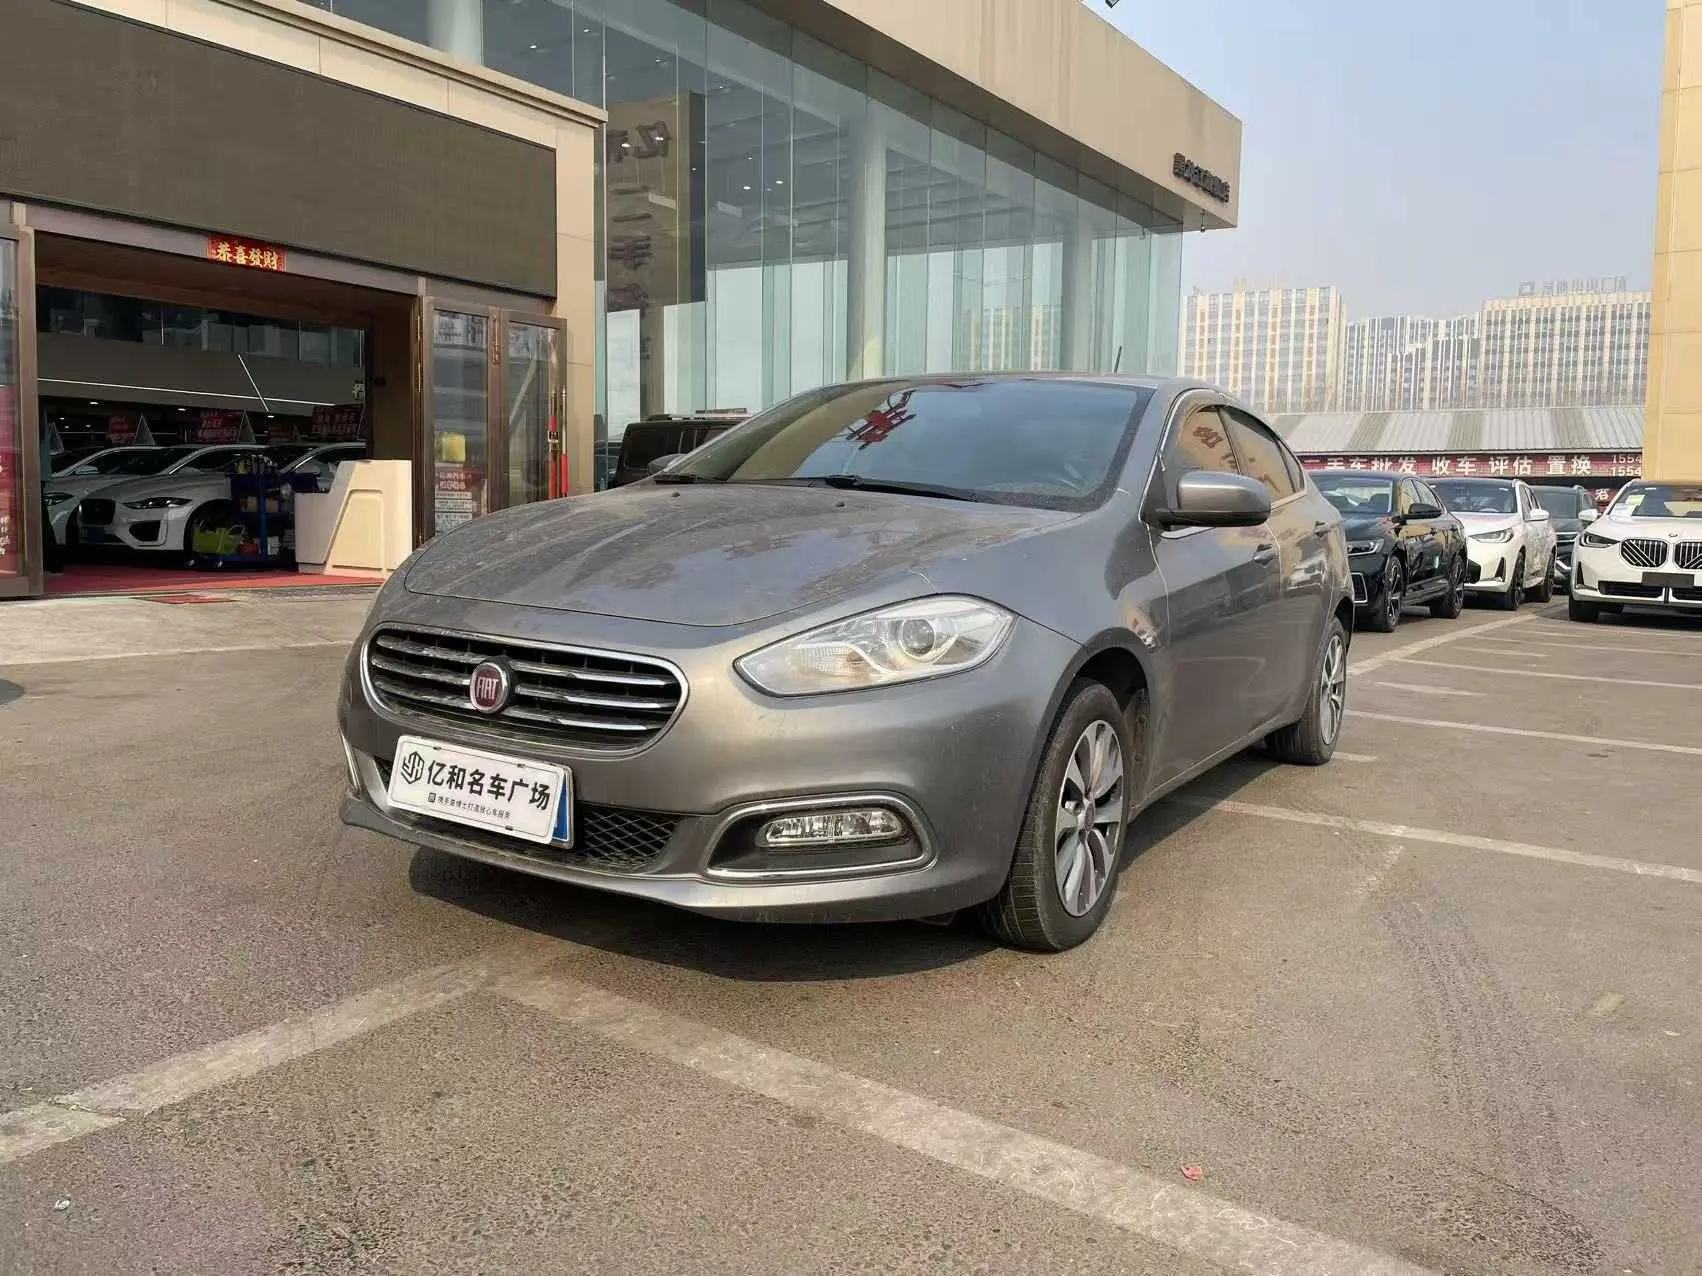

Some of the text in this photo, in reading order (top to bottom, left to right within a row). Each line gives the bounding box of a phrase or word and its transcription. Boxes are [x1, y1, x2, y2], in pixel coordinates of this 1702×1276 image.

[216, 241, 278, 270] 恭喜發財
[1431, 456, 1477, 475] 收车
[1489, 456, 1533, 476] 评估
[1547, 455, 1592, 475] 置换
[476, 676, 499, 700] FIAT
[427, 759, 551, 810] 亿和名车广场
